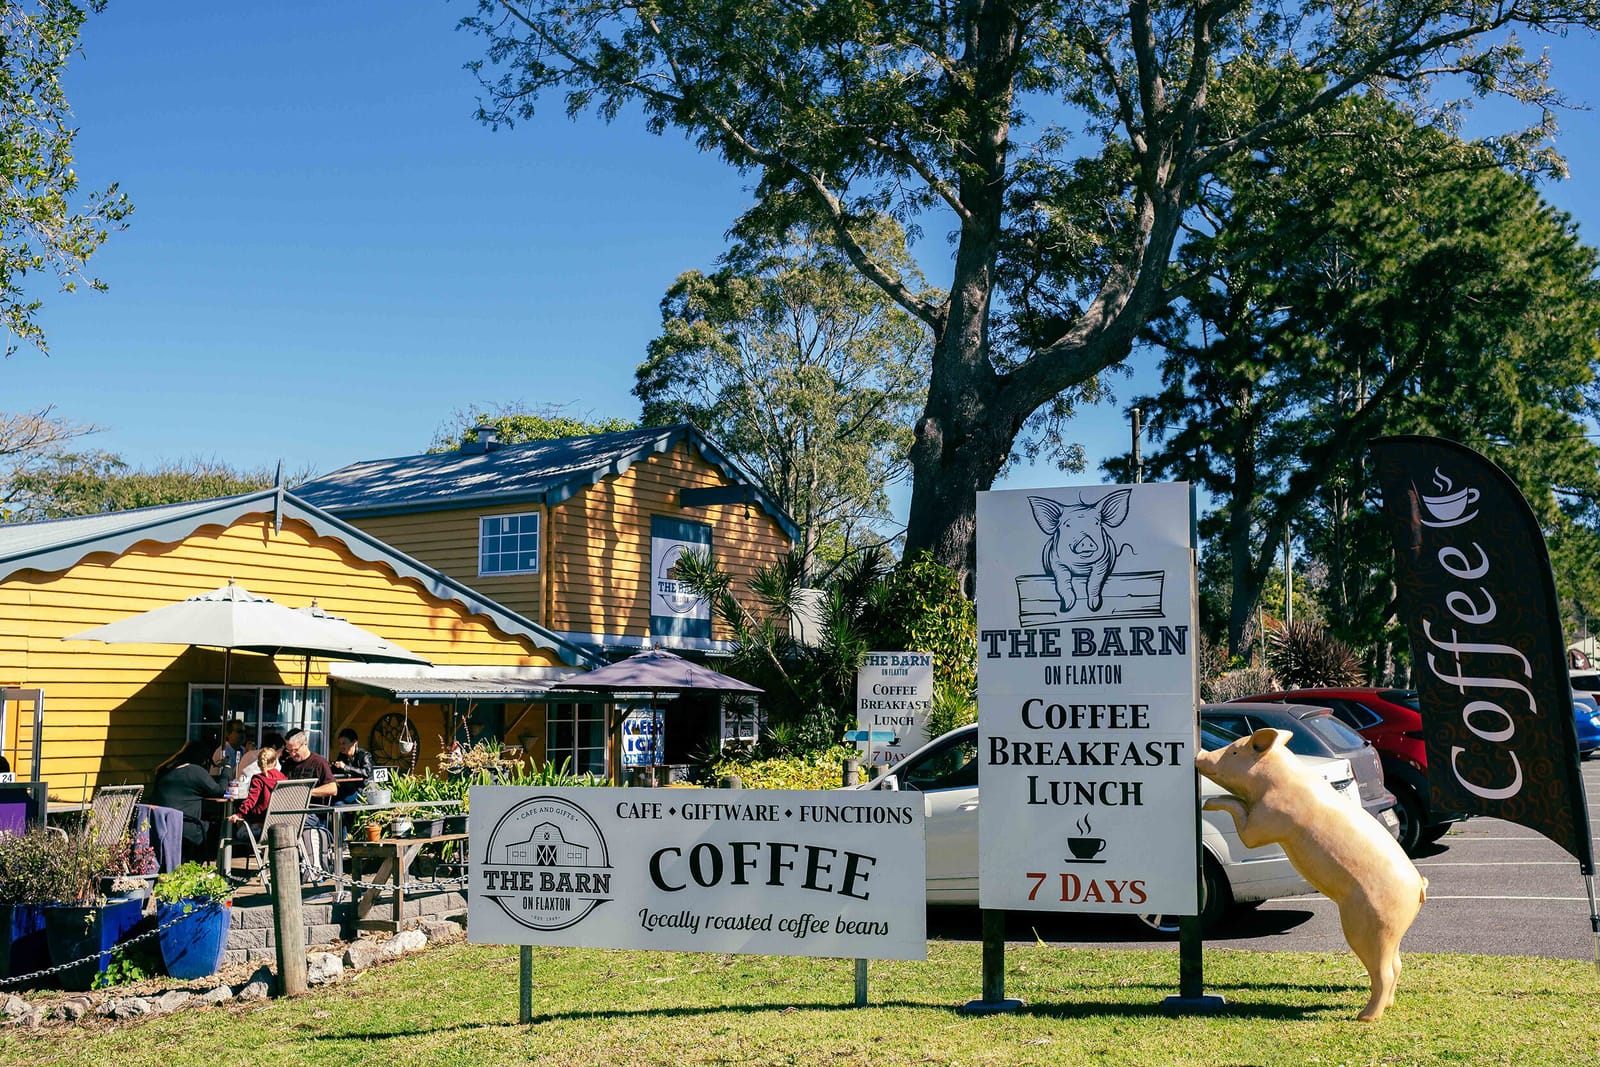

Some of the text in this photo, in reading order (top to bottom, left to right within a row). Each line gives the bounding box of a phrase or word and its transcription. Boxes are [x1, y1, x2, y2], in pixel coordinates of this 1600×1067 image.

[981, 626, 1188, 658] THE BARN
[891, 655, 931, 667] BARN
[1422, 541, 1537, 800] Coffee
[1045, 664, 1122, 685] ON FLAXTON
[872, 684, 917, 696] COFFEE
[861, 699, 930, 710] BREAKFAST
[1021, 698, 1150, 730] COFFEE
[874, 715, 914, 726] LUNCH
[873, 751, 910, 762] 7 DAY
[988, 736, 1185, 767] BREAKFAST
[2, 773, 13, 783] 24
[375, 769, 386, 779] 23
[1027, 775, 1143, 806] LUNCH
[521, 808, 538, 819] CAFE
[555, 808, 575, 820] GIFTS
[616, 802, 913, 824] CAFE GIFTWARE FUNCTIONS
[649, 841, 877, 901] COFFEE
[483, 870, 611, 894] THE BARN
[1026, 872, 1148, 905] 7 DAYS
[522, 896, 571, 911] ON FLAXTON
[638, 908, 889, 938] Locally roasted coffee beans
